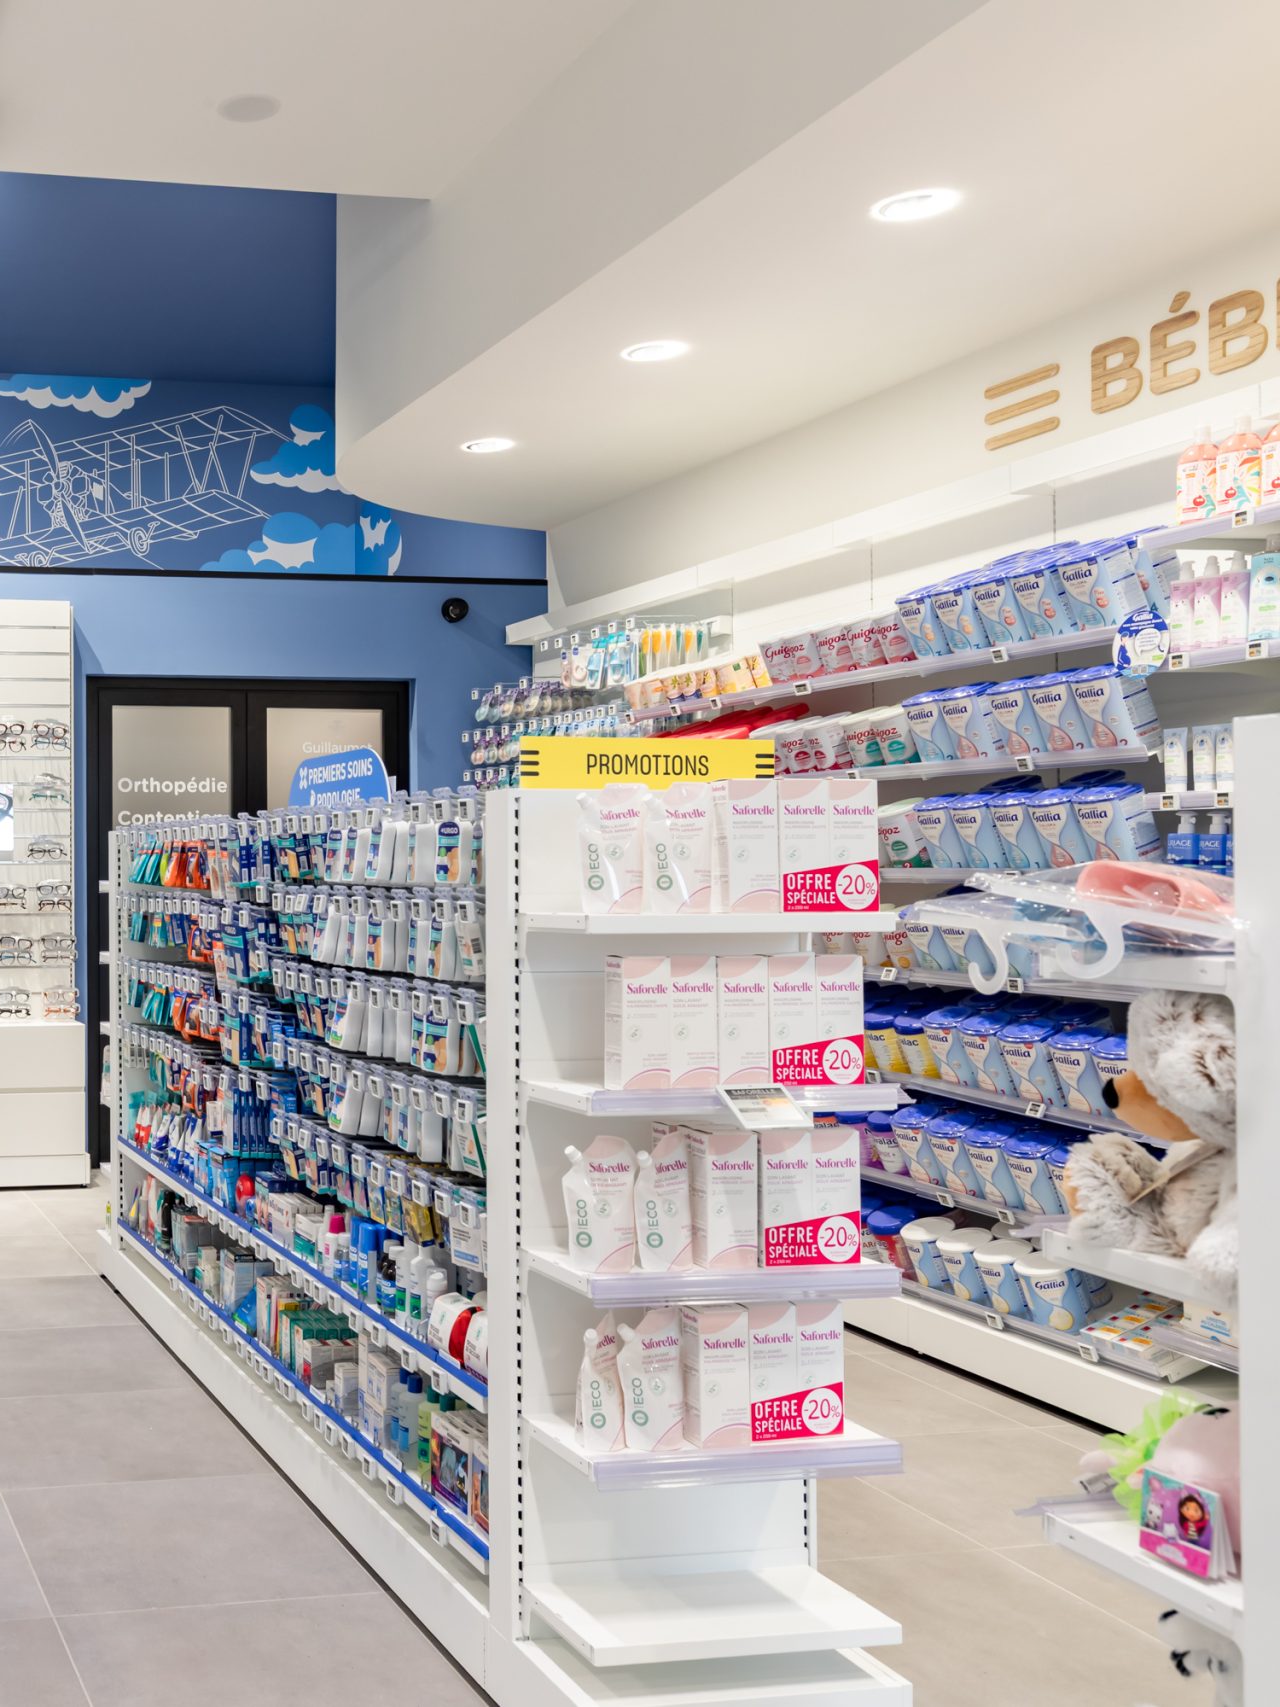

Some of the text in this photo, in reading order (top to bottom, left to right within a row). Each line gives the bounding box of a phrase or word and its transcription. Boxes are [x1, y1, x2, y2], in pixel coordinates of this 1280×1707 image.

[1091, 277, 1280, 415] BÉB
[1062, 568, 1093, 582] Gallia
[1013, 580, 1040, 593] Gallia
[974, 589, 1000, 601] Gallia
[934, 599, 959, 610] Gallia
[876, 623, 900, 639] igoz
[816, 633, 847, 650] uigoz
[1032, 693, 1062, 705] Gallia
[1075, 687, 1104, 700] Gallia
[943, 705, 967, 716] Gallia
[991, 699, 1018, 711] Gallia
[907, 710, 933, 721] Gallia
[875, 727, 898, 742] igoz
[302, 741, 373, 753] Guillaum
[308, 758, 373, 786] PREMIERS SOINS
[586, 753, 709, 777] PROMOTIONS
[118, 777, 228, 796] Orthopédie
[732, 804, 775, 816] Saforelle
[784, 804, 826, 816] Saforelle
[833, 804, 875, 816] Saforelle
[1032, 811, 1061, 822] Gallia
[1078, 808, 1108, 820] Gallia
[588, 843, 600, 870] ECO
[656, 843, 669, 870] ECO
[786, 873, 832, 890] OFFRE
[838, 874, 876, 896] -20%
[786, 889, 836, 905] SPÉCIALE
[627, 983, 668, 994] Saforelle
[672, 982, 714, 993] Saforelle
[724, 982, 765, 993] Saforelle
[773, 981, 813, 993] Saforelle
[820, 981, 861, 992] Saforelle
[776, 1049, 819, 1066] OFFRE
[825, 1049, 861, 1070] -20%
[1052, 1052, 1081, 1067] Gallia
[776, 1066, 823, 1080] SPÉCIALE
[711, 1160, 754, 1171] Saforelle
[766, 1159, 808, 1170] Saforelle
[815, 1157, 857, 1169] Saforelle
[576, 1199, 588, 1227] ECO
[646, 1199, 659, 1227] ECO
[769, 1226, 814, 1243] OFFRE
[819, 1226, 858, 1248] -20%
[769, 1243, 818, 1259] SPÉCIALE
[1034, 1279, 1065, 1291] Gallia
[752, 1333, 794, 1345] Saforelle
[800, 1330, 841, 1342] Saforelle
[703, 1338, 745, 1350] Saforelle
[590, 1380, 602, 1408] ECO
[632, 1377, 644, 1405] ECO
[755, 1399, 798, 1419] OFFRE
[804, 1398, 841, 1420] -20%
[755, 1417, 802, 1433] SPÉCIALE
